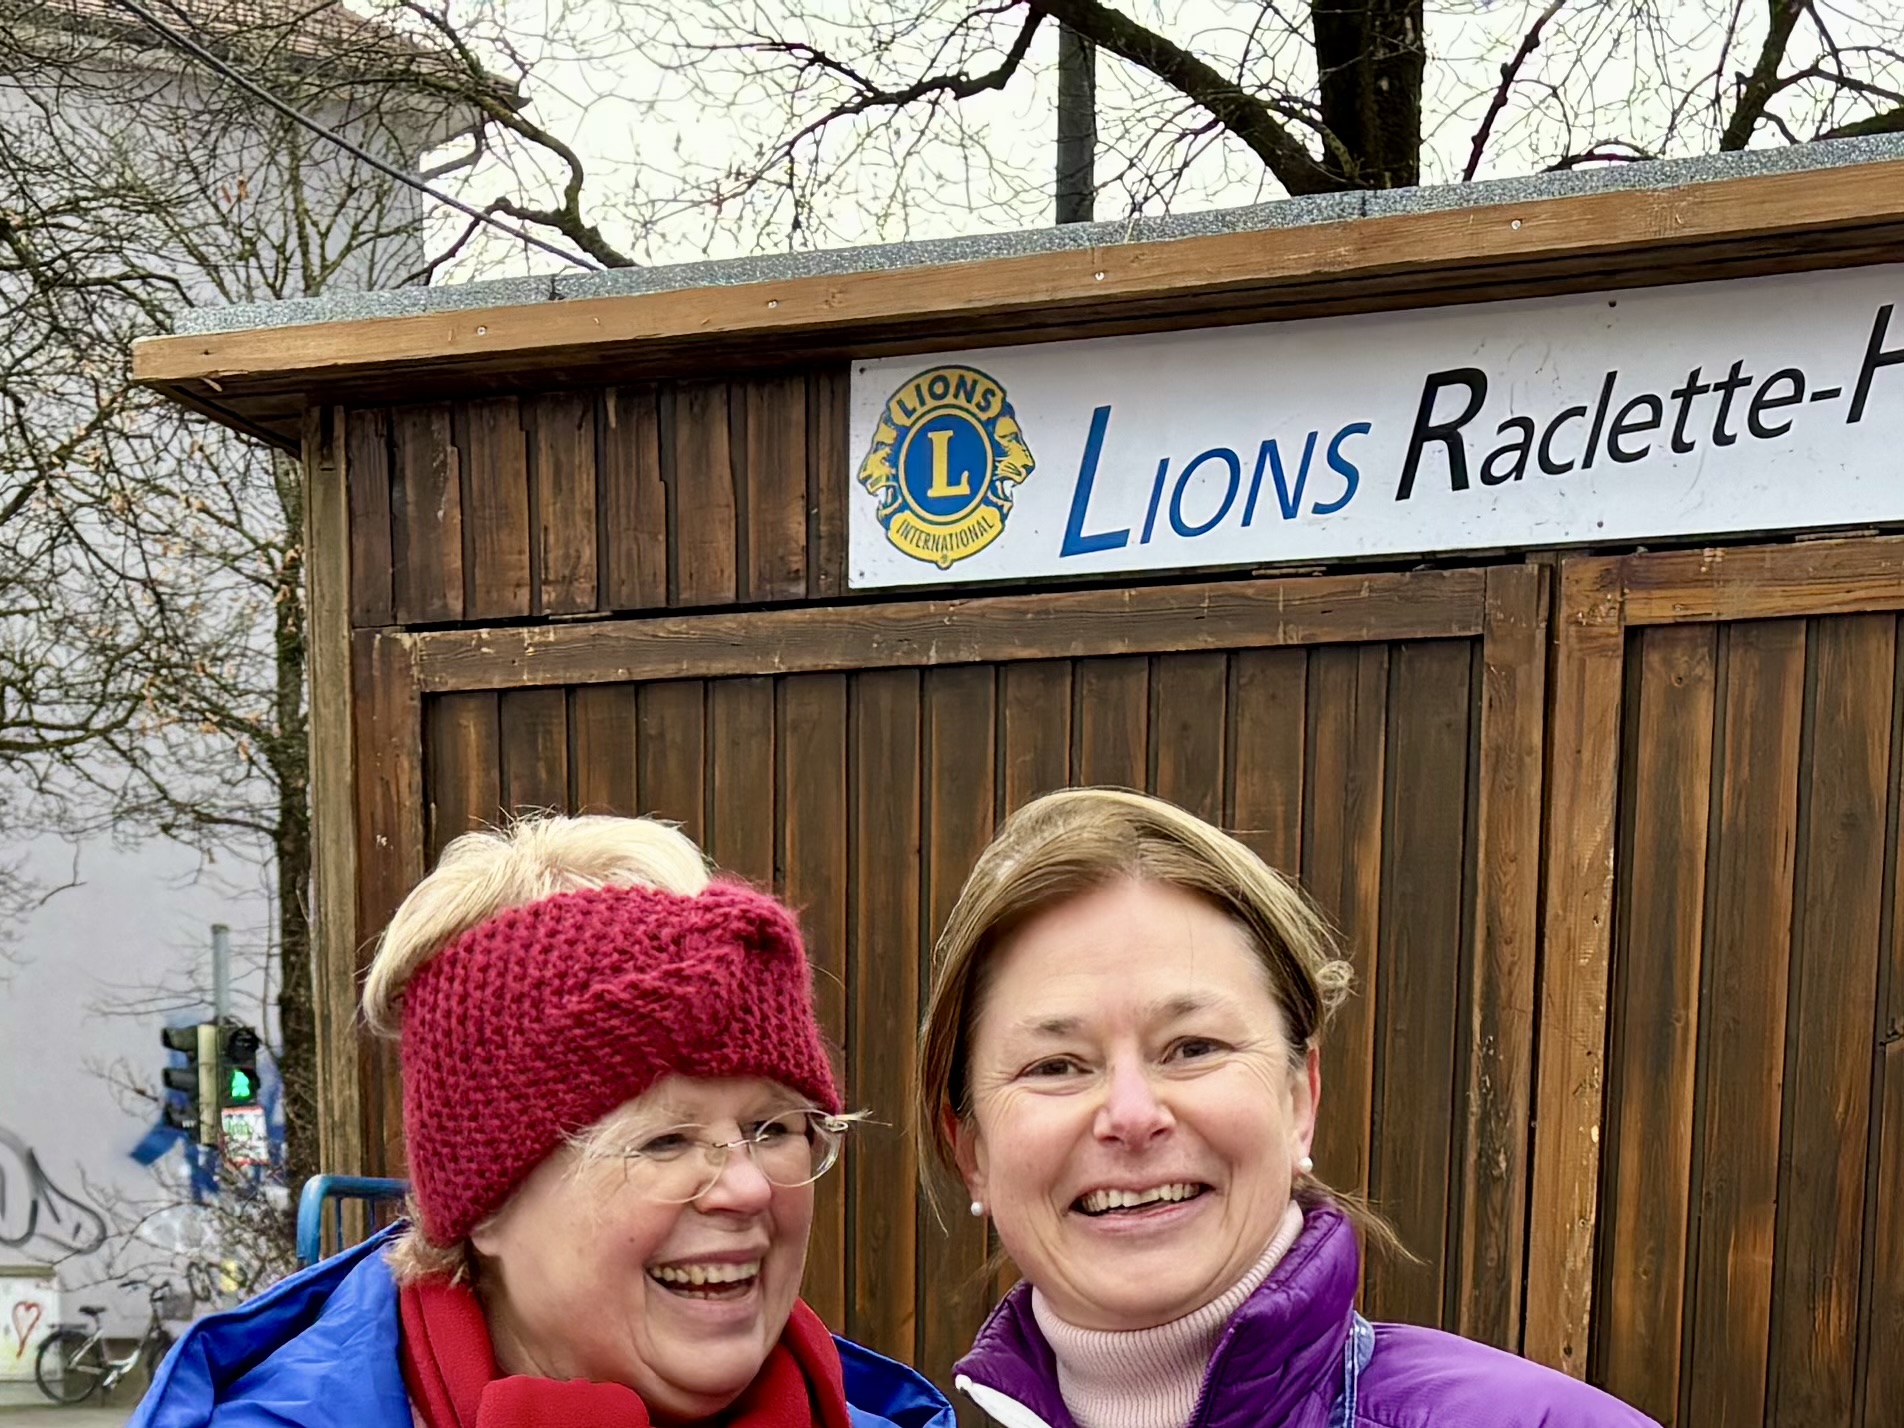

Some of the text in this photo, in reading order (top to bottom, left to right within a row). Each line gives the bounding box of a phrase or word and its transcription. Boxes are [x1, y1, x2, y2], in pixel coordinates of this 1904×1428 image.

[897, 374, 996, 419] LIONS
[927, 430, 971, 498] L
[896, 514, 994, 553] INTERNATIONAL
